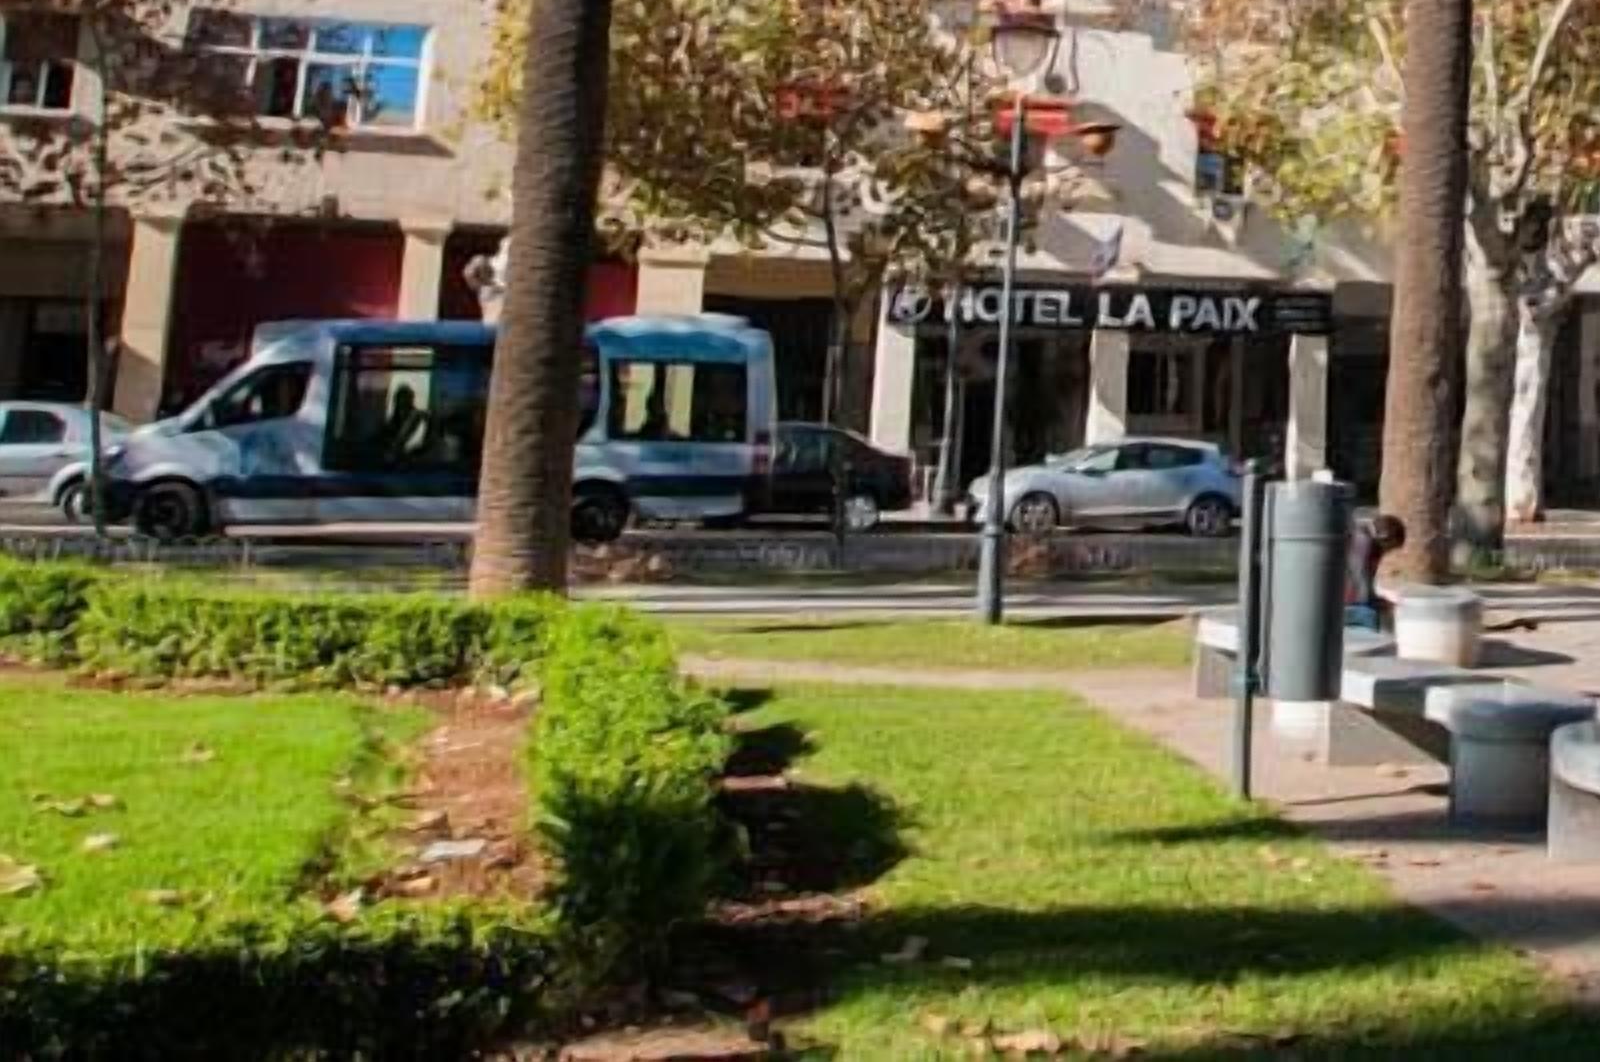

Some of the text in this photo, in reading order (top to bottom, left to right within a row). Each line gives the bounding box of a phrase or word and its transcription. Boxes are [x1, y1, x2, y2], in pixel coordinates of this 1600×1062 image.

[942, 286, 1083, 324] HOTEL
[1099, 292, 1155, 328] LA
[1170, 295, 1261, 332] PAIX
